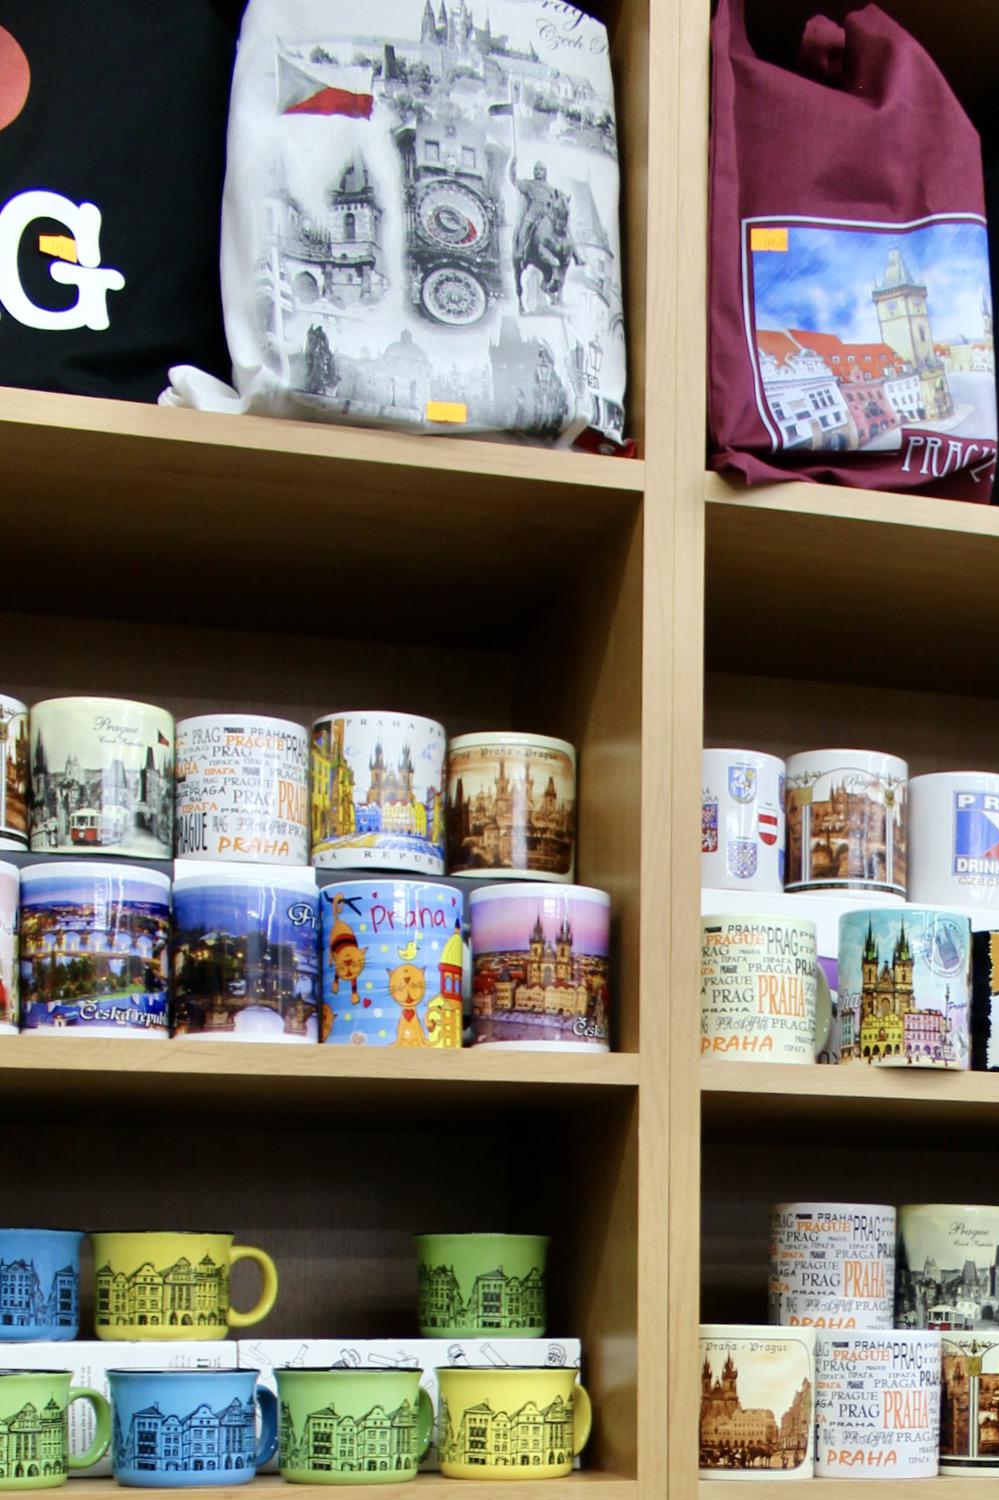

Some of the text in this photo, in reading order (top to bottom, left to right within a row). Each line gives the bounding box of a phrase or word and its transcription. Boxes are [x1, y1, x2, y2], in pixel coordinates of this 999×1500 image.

[93, 715, 140, 738] Prague
[225, 735, 285, 751] PRAGUE
[212, 746, 252, 758] PRAG
[233, 789, 275, 805] PRAG
[217, 836, 290, 856] PRAHA
[727, 924, 768, 935] PRAHA
[706, 934, 765, 946] PRAGUE
[766, 926, 799, 957] PRAG
[702, 945, 730, 958] RAG
[748, 963, 793, 975] PRAGA
[703, 976, 754, 987] PRAGUE
[712, 988, 755, 1004] PRAG
[756, 974, 806, 1018] PRAHA
[700, 1034, 774, 1055] PRAHA
[816, 1213, 854, 1223] PRAHA
[796, 1221, 852, 1233] PRAGUE
[853, 1215, 881, 1242] PRAG
[948, 1221, 990, 1241] Prague
[786, 1231, 819, 1243] PRAG
[835, 1249, 876, 1260] PRAGA
[794, 1261, 840, 1271] PRAGUE
[801, 1272, 841, 1288] PRAG
[842, 1260, 887, 1298] PRAHA
[789, 1315, 858, 1330] PRAHA
[705, 1341, 788, 1355] Praha Prague
[854, 1340, 893, 1351] PRAHA
[831, 1349, 891, 1362] PRAGUE
[892, 1342, 923, 1371] PRAG
[822, 1360, 856, 1372] PRAG
[873, 1378, 917, 1389] PRAGA
[831, 1391, 879, 1402] PRAGUE
[838, 1403, 881, 1419] PRAG
[883, 1390, 930, 1430] PRAHA
[825, 1448, 898, 1467] PRAHA
